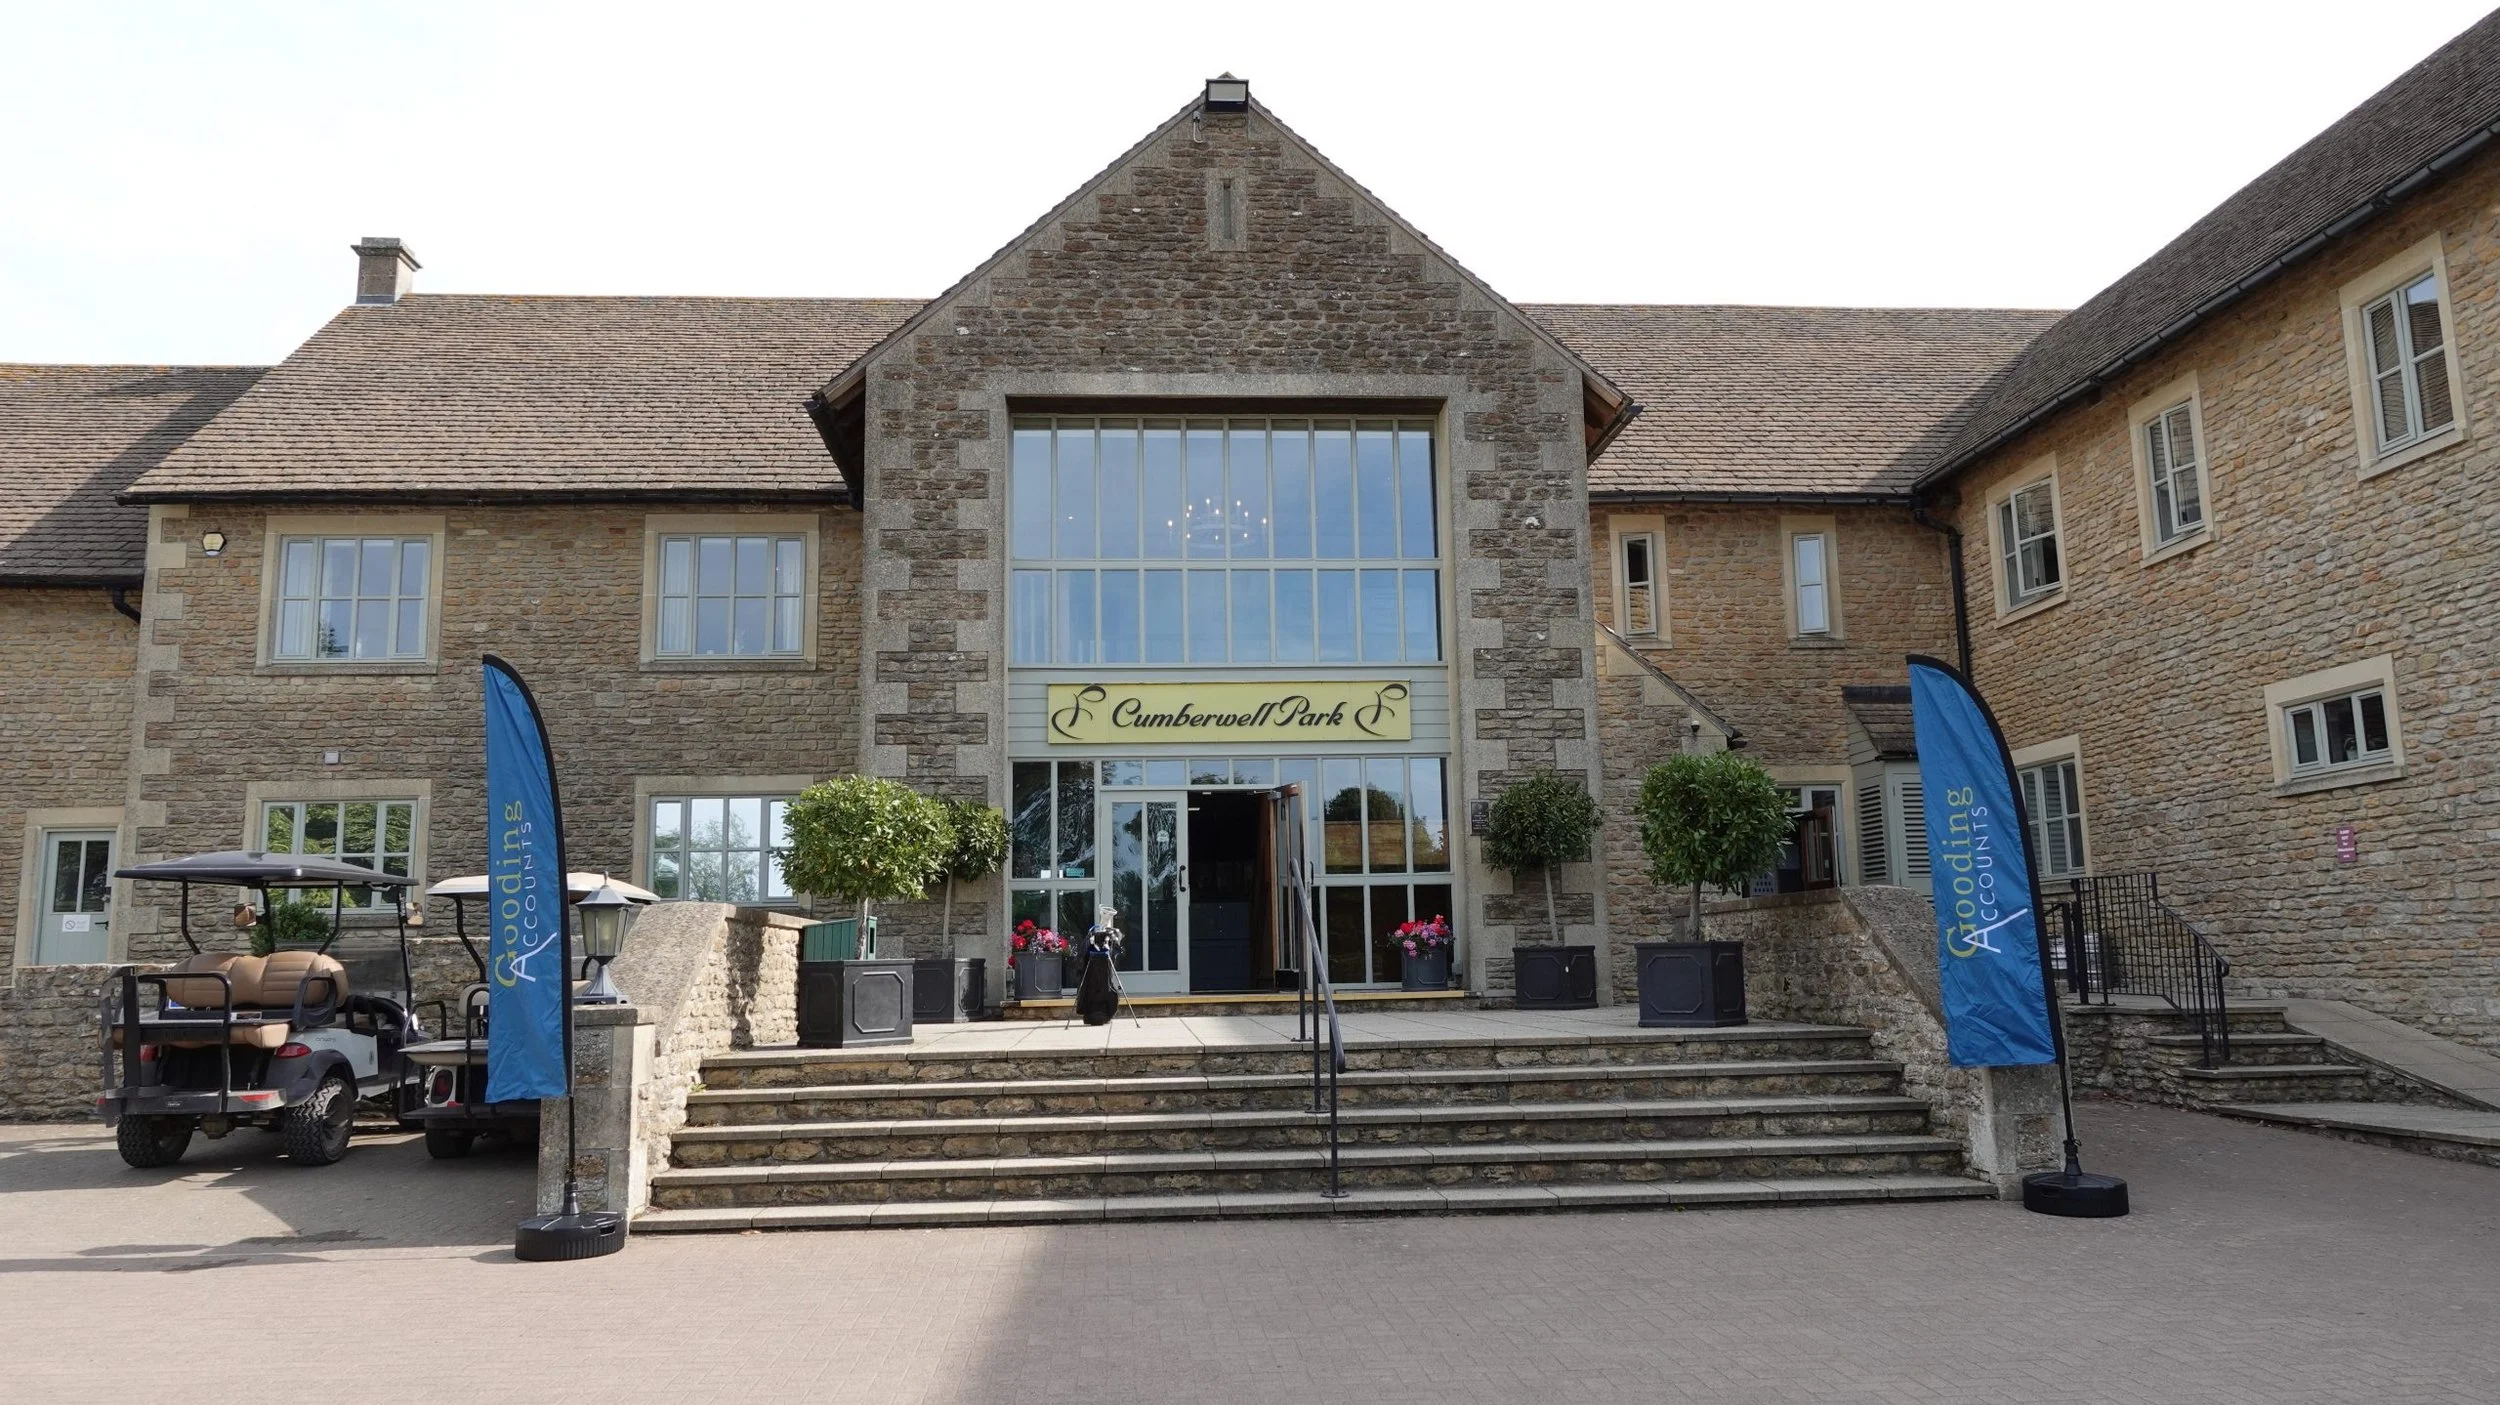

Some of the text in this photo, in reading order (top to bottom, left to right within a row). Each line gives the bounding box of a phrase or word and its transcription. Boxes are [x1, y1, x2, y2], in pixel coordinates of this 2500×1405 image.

[1112, 695, 1347, 728] Cumberwell Park
[494, 800, 522, 987] Gooding
[509, 822, 557, 982] ACCOUNTS
[1942, 786, 1978, 958] Gooding
[1962, 806, 2028, 954] ACCOUNTS
